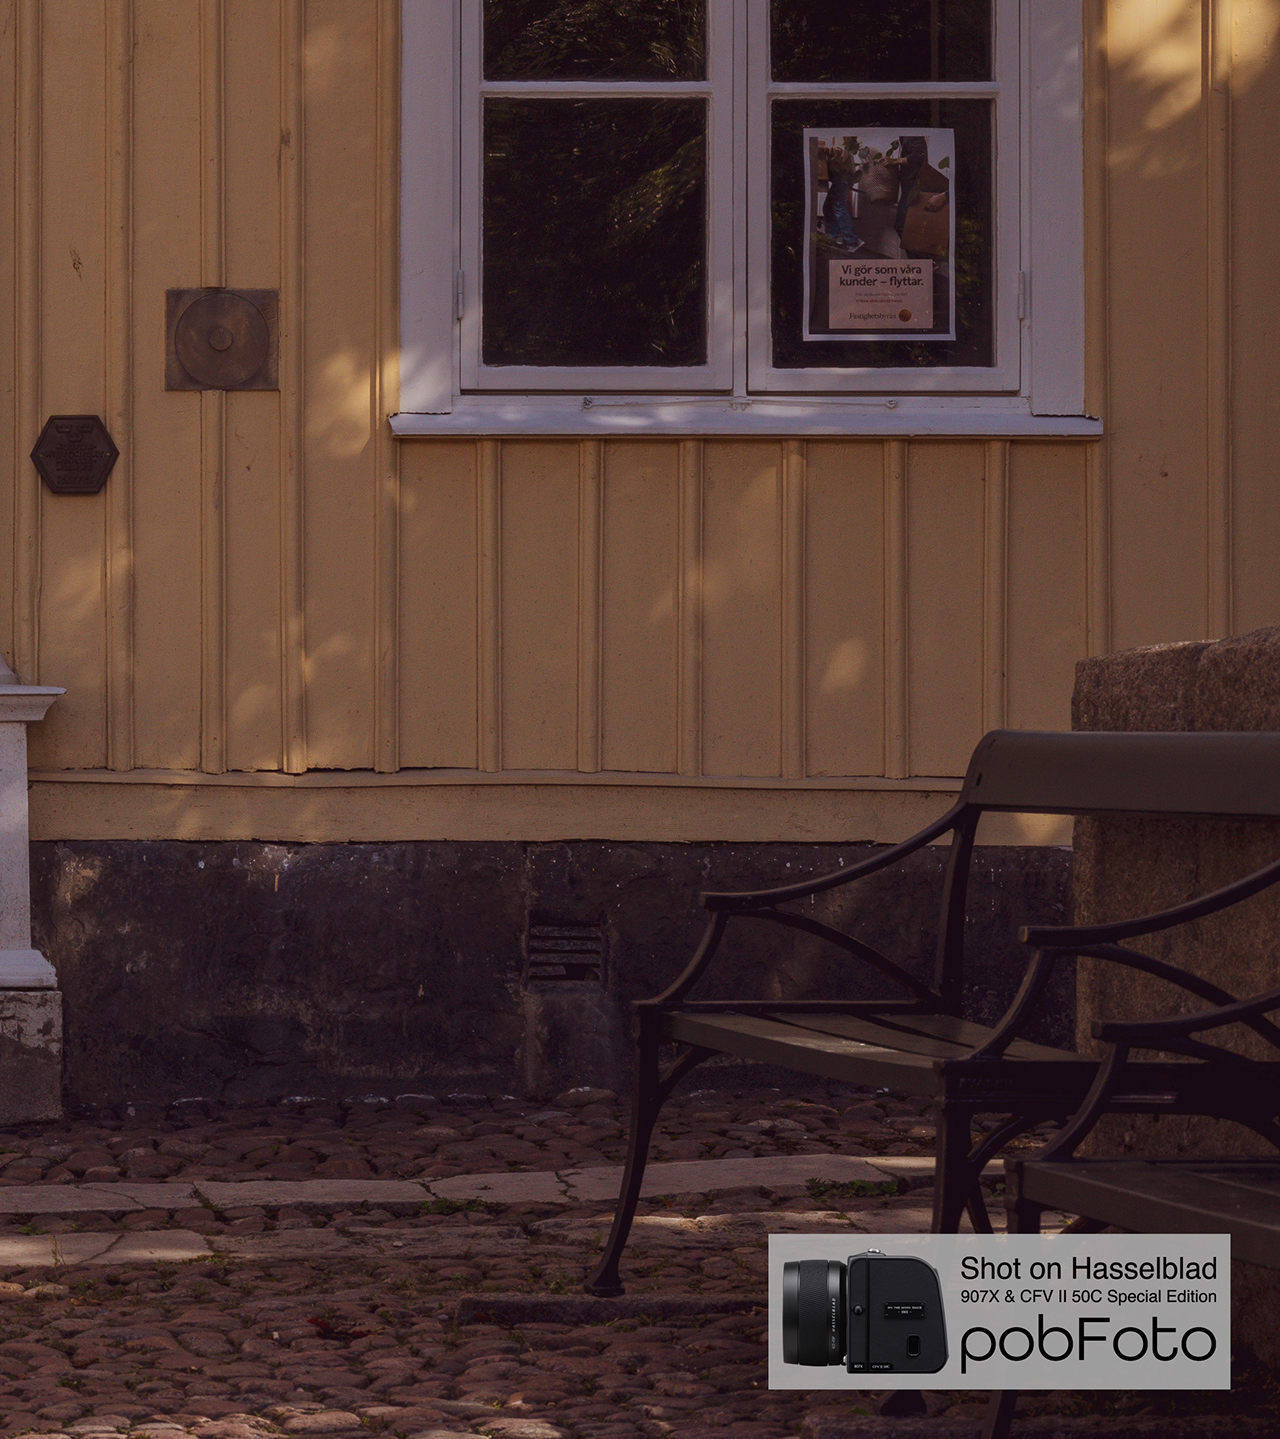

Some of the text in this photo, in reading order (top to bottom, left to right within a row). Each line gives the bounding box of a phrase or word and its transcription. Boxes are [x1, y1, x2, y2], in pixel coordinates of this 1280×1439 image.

[841, 264, 922, 276] Vi gör som våra
[839, 276, 878, 286] kunder
[889, 276, 924, 288] flyttar.
[849, 312, 897, 321] Fastighetsbyrån
